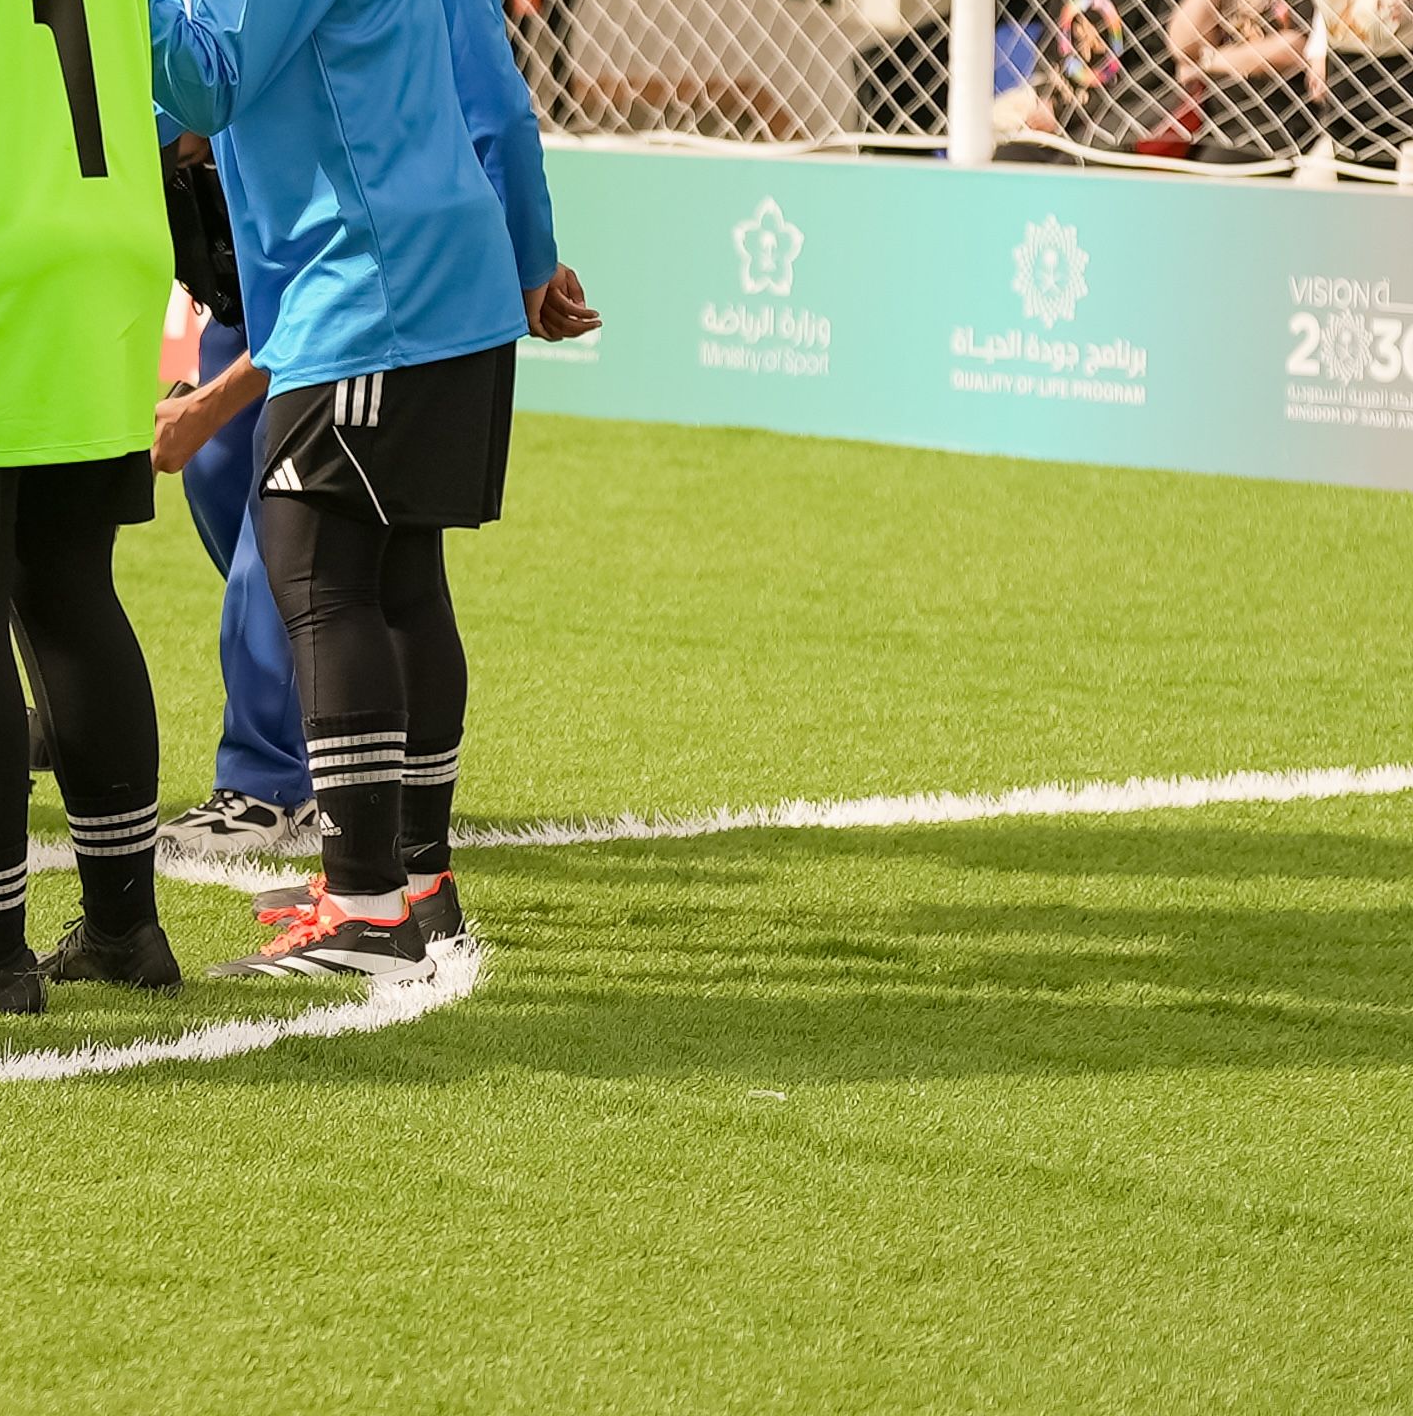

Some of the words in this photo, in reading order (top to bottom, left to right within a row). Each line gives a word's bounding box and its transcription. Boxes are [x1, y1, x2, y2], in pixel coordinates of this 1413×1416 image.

[1289, 275, 1371, 309] VISION
[700, 341, 761, 374] Ministry
[784, 349, 830, 376] Sport
[952, 368, 1014, 394] QUALITY
[1016, 374, 1037, 396] OF
[1039, 376, 1069, 401] LIFE
[1071, 379, 1147, 407] PROGRAM
